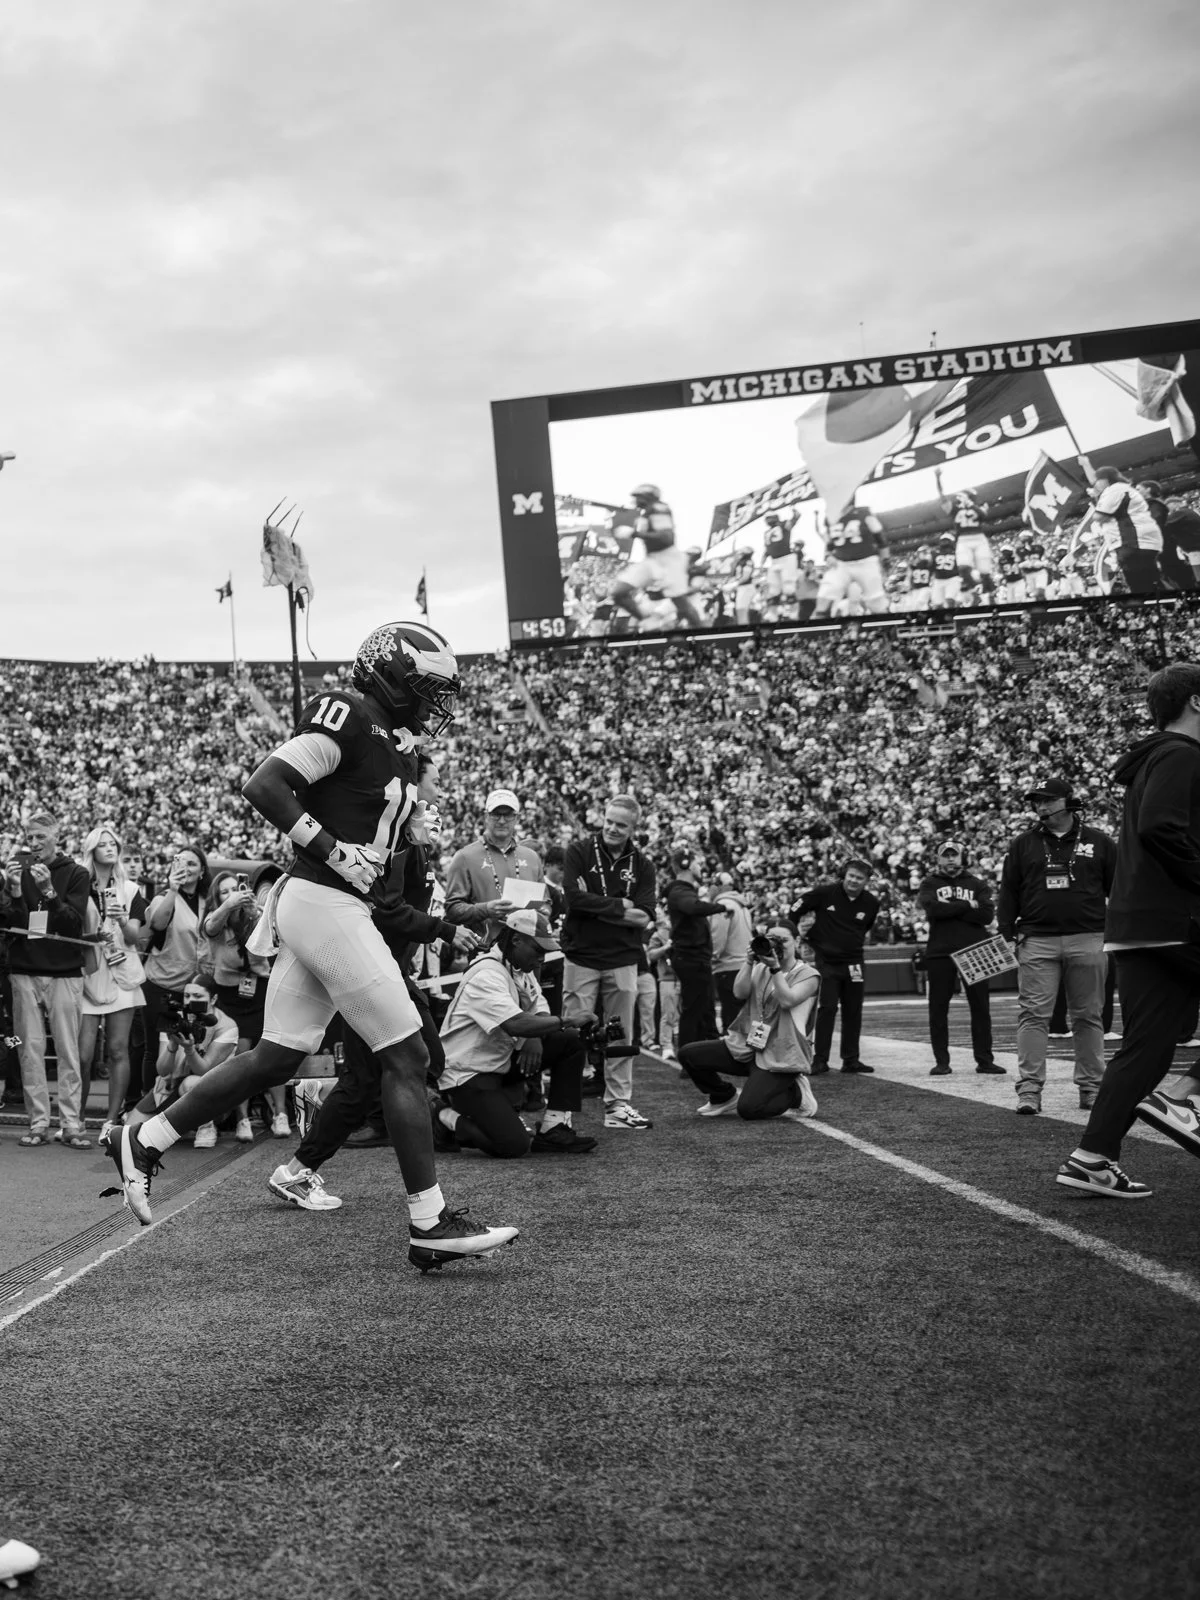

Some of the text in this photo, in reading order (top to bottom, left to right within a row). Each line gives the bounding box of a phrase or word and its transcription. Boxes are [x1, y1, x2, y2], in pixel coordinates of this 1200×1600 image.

[690, 339, 1074, 406] MICHIGAN STADIUM
[934, 403, 1040, 460] YOU
[511, 491, 544, 516] M
[1029, 472, 1073, 522] M
[522, 617, 566, 639] 4:50
[310, 697, 351, 731] 10
